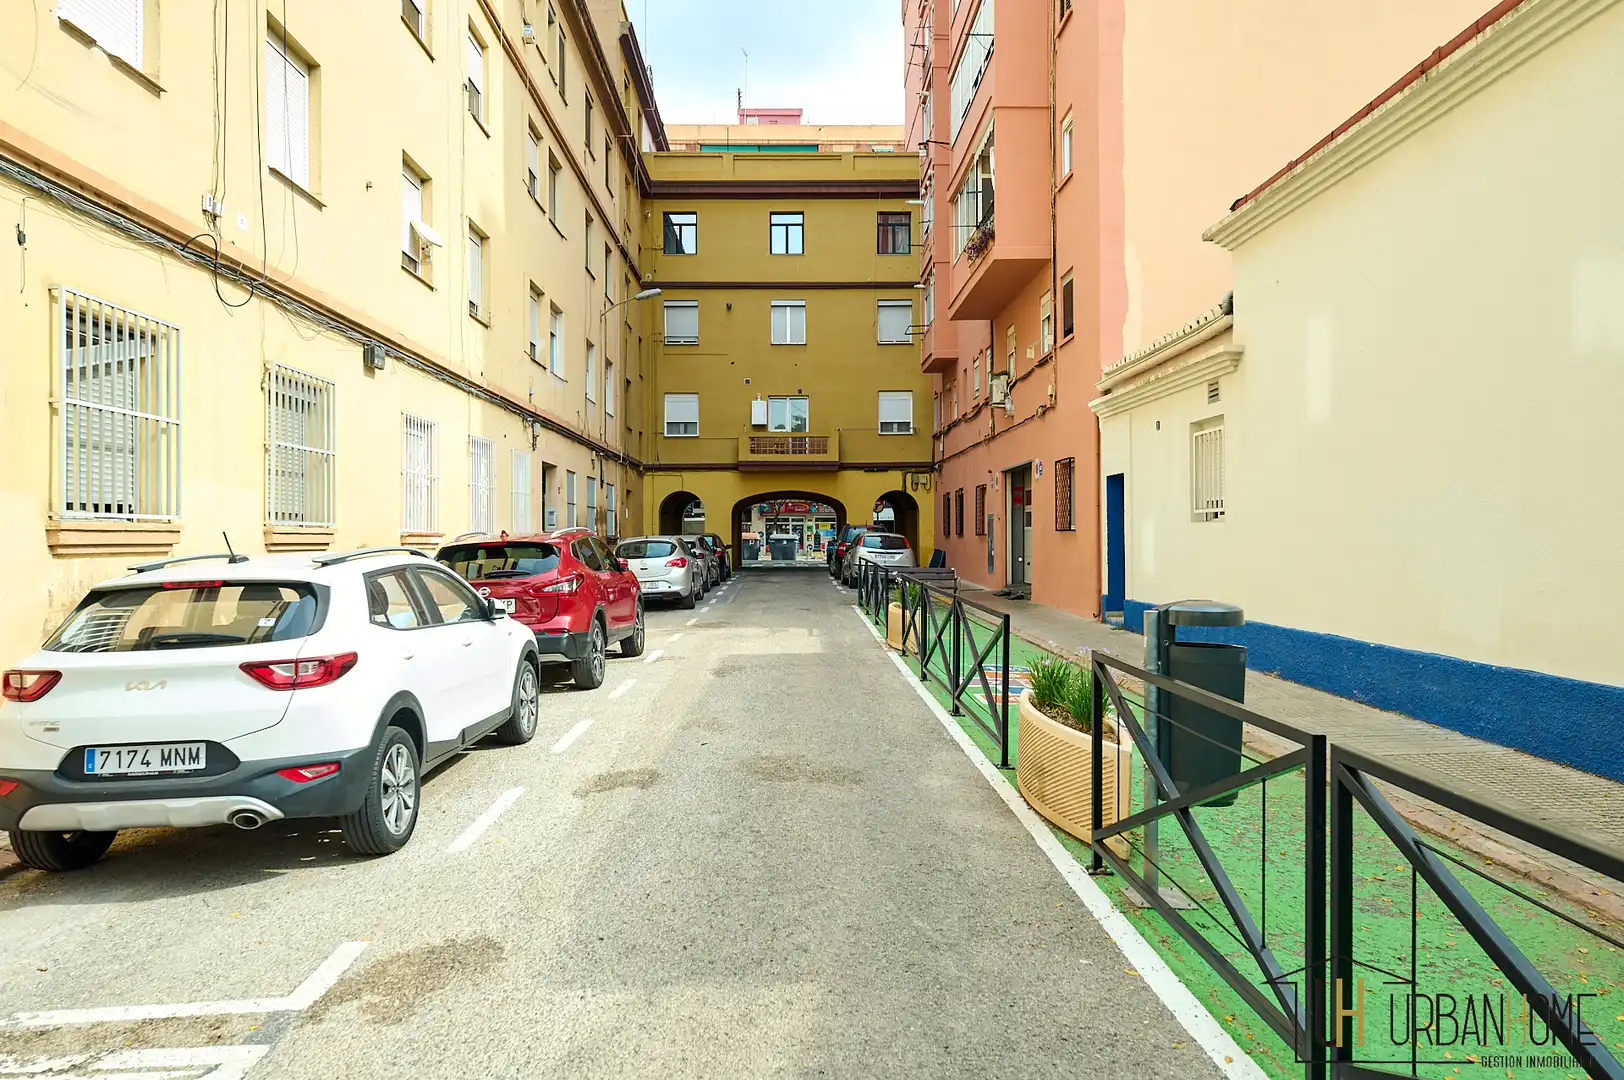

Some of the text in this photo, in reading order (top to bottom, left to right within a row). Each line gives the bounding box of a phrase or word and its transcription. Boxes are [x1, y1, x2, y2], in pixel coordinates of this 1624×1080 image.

[125, 680, 167, 691] KIA
[100, 747, 200, 770] 7174 MNM
